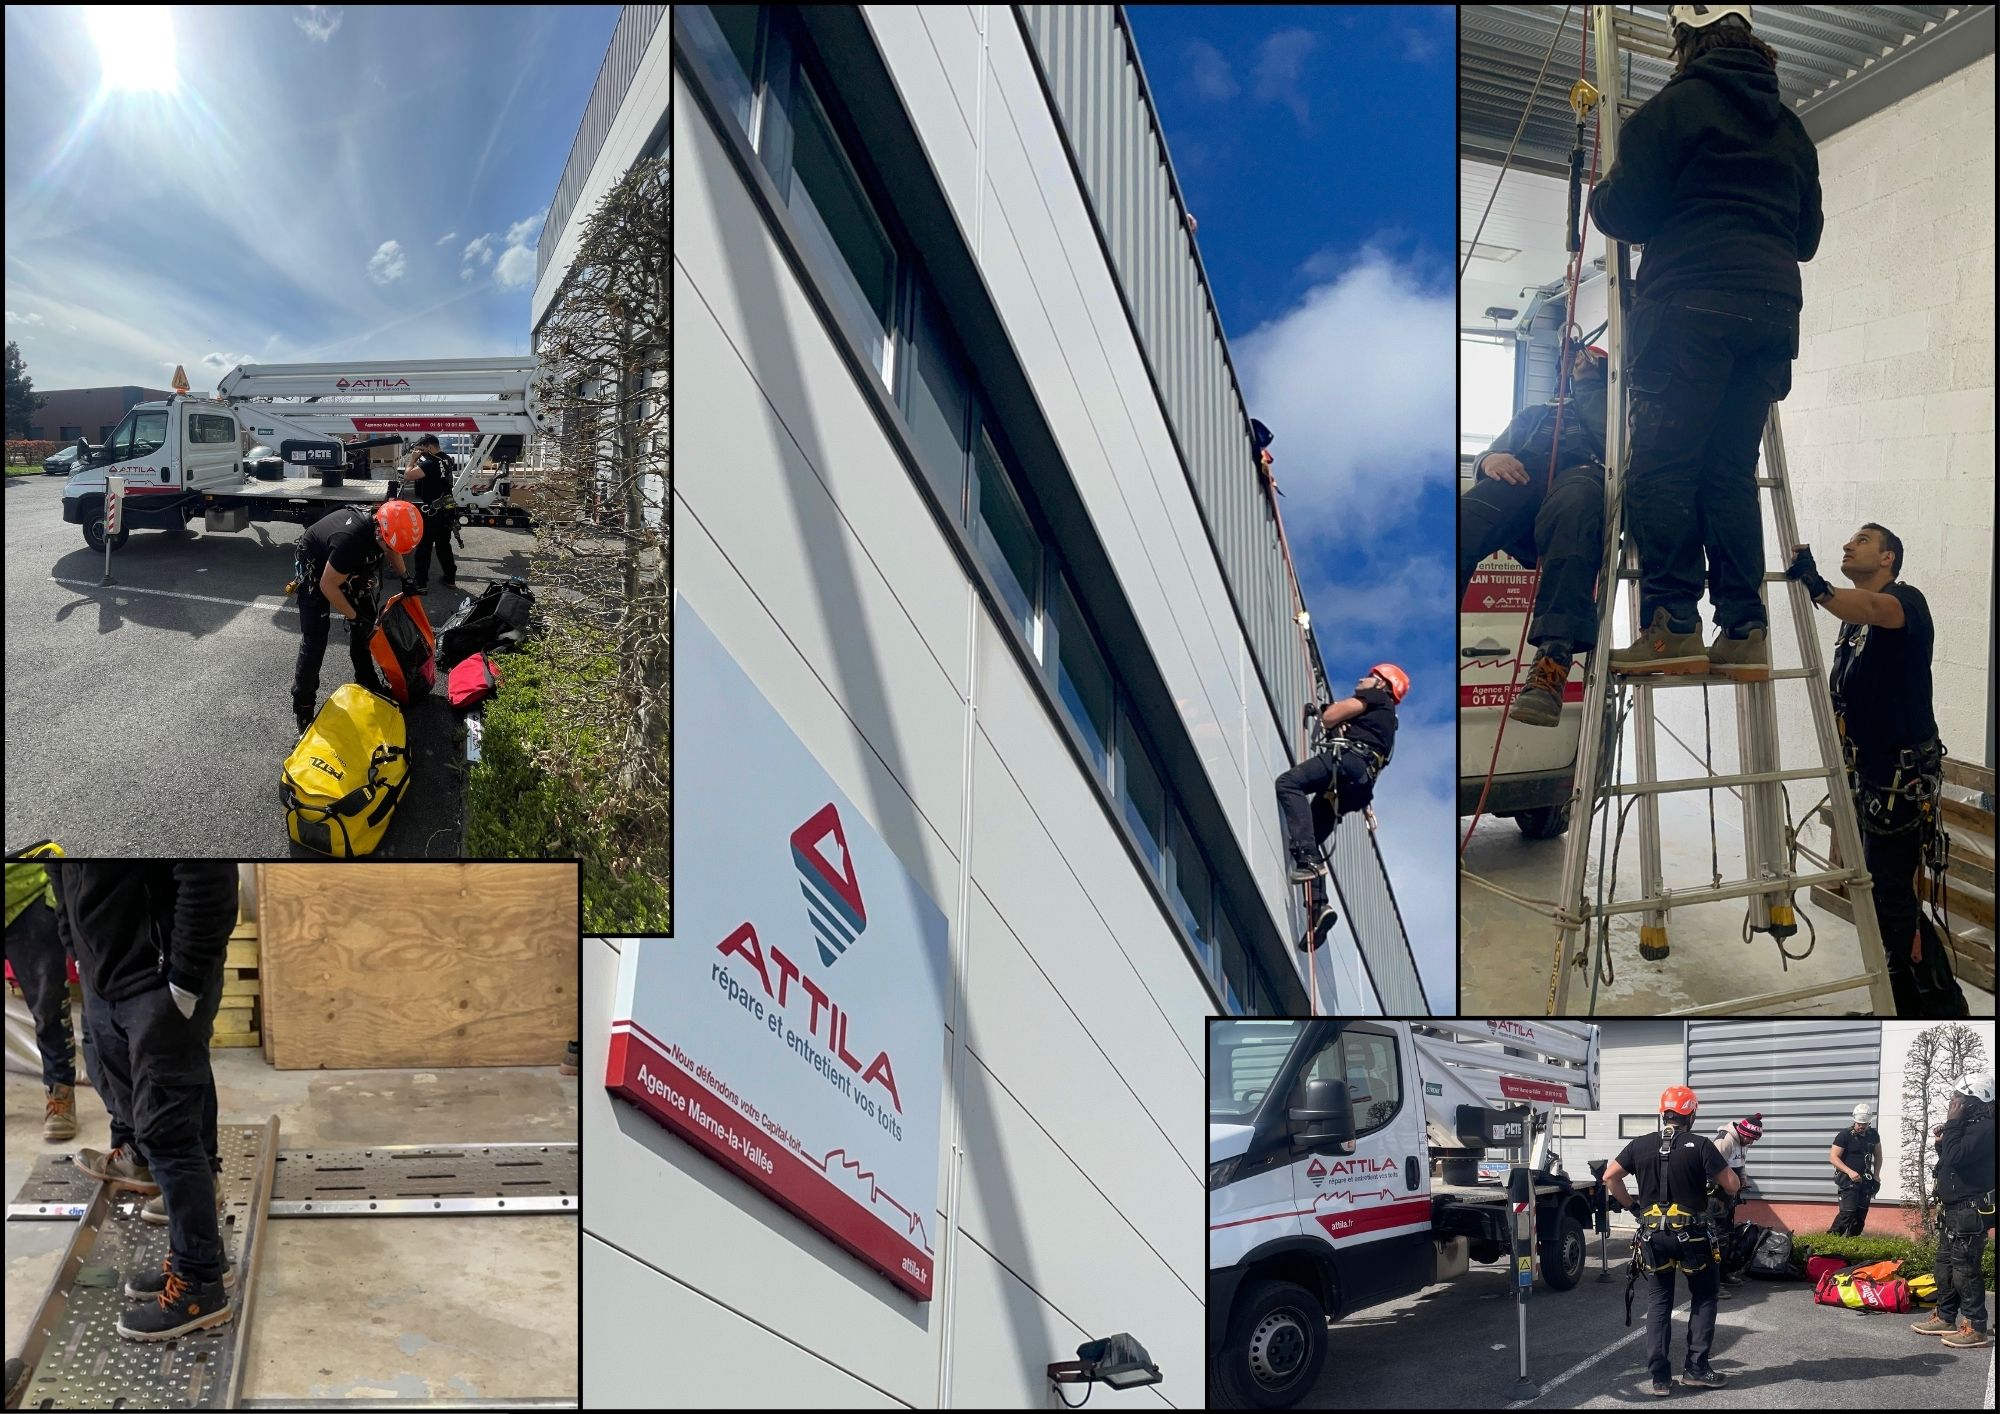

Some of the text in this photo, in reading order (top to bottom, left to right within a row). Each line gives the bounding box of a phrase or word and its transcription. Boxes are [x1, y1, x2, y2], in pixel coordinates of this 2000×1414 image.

[352, 378, 410, 388] ATTILA
[1479, 562, 1525, 571] entretien
[1470, 574, 1488, 584] LAN
[1490, 575, 1527, 585] TOITURE
[1472, 686, 1502, 695] Agence
[1472, 695, 1486, 705] 01
[1491, 695, 1504, 704] 74
[310, 756, 345, 781] PETZL
[716, 922, 903, 1116] ATTILA
[1497, 1020, 1535, 1040] ATTILA
[711, 962, 902, 1142] répare et entretient vos toits
[671, 1043, 802, 1152] Nous défendons votre Capital-toit
[637, 1064, 774, 1175] Agence Marne-la-Vallée
[1330, 1157, 1398, 1176] ATTILA
[1331, 1219, 1354, 1231] attila.fr
[901, 1257, 928, 1285] attila.fr
